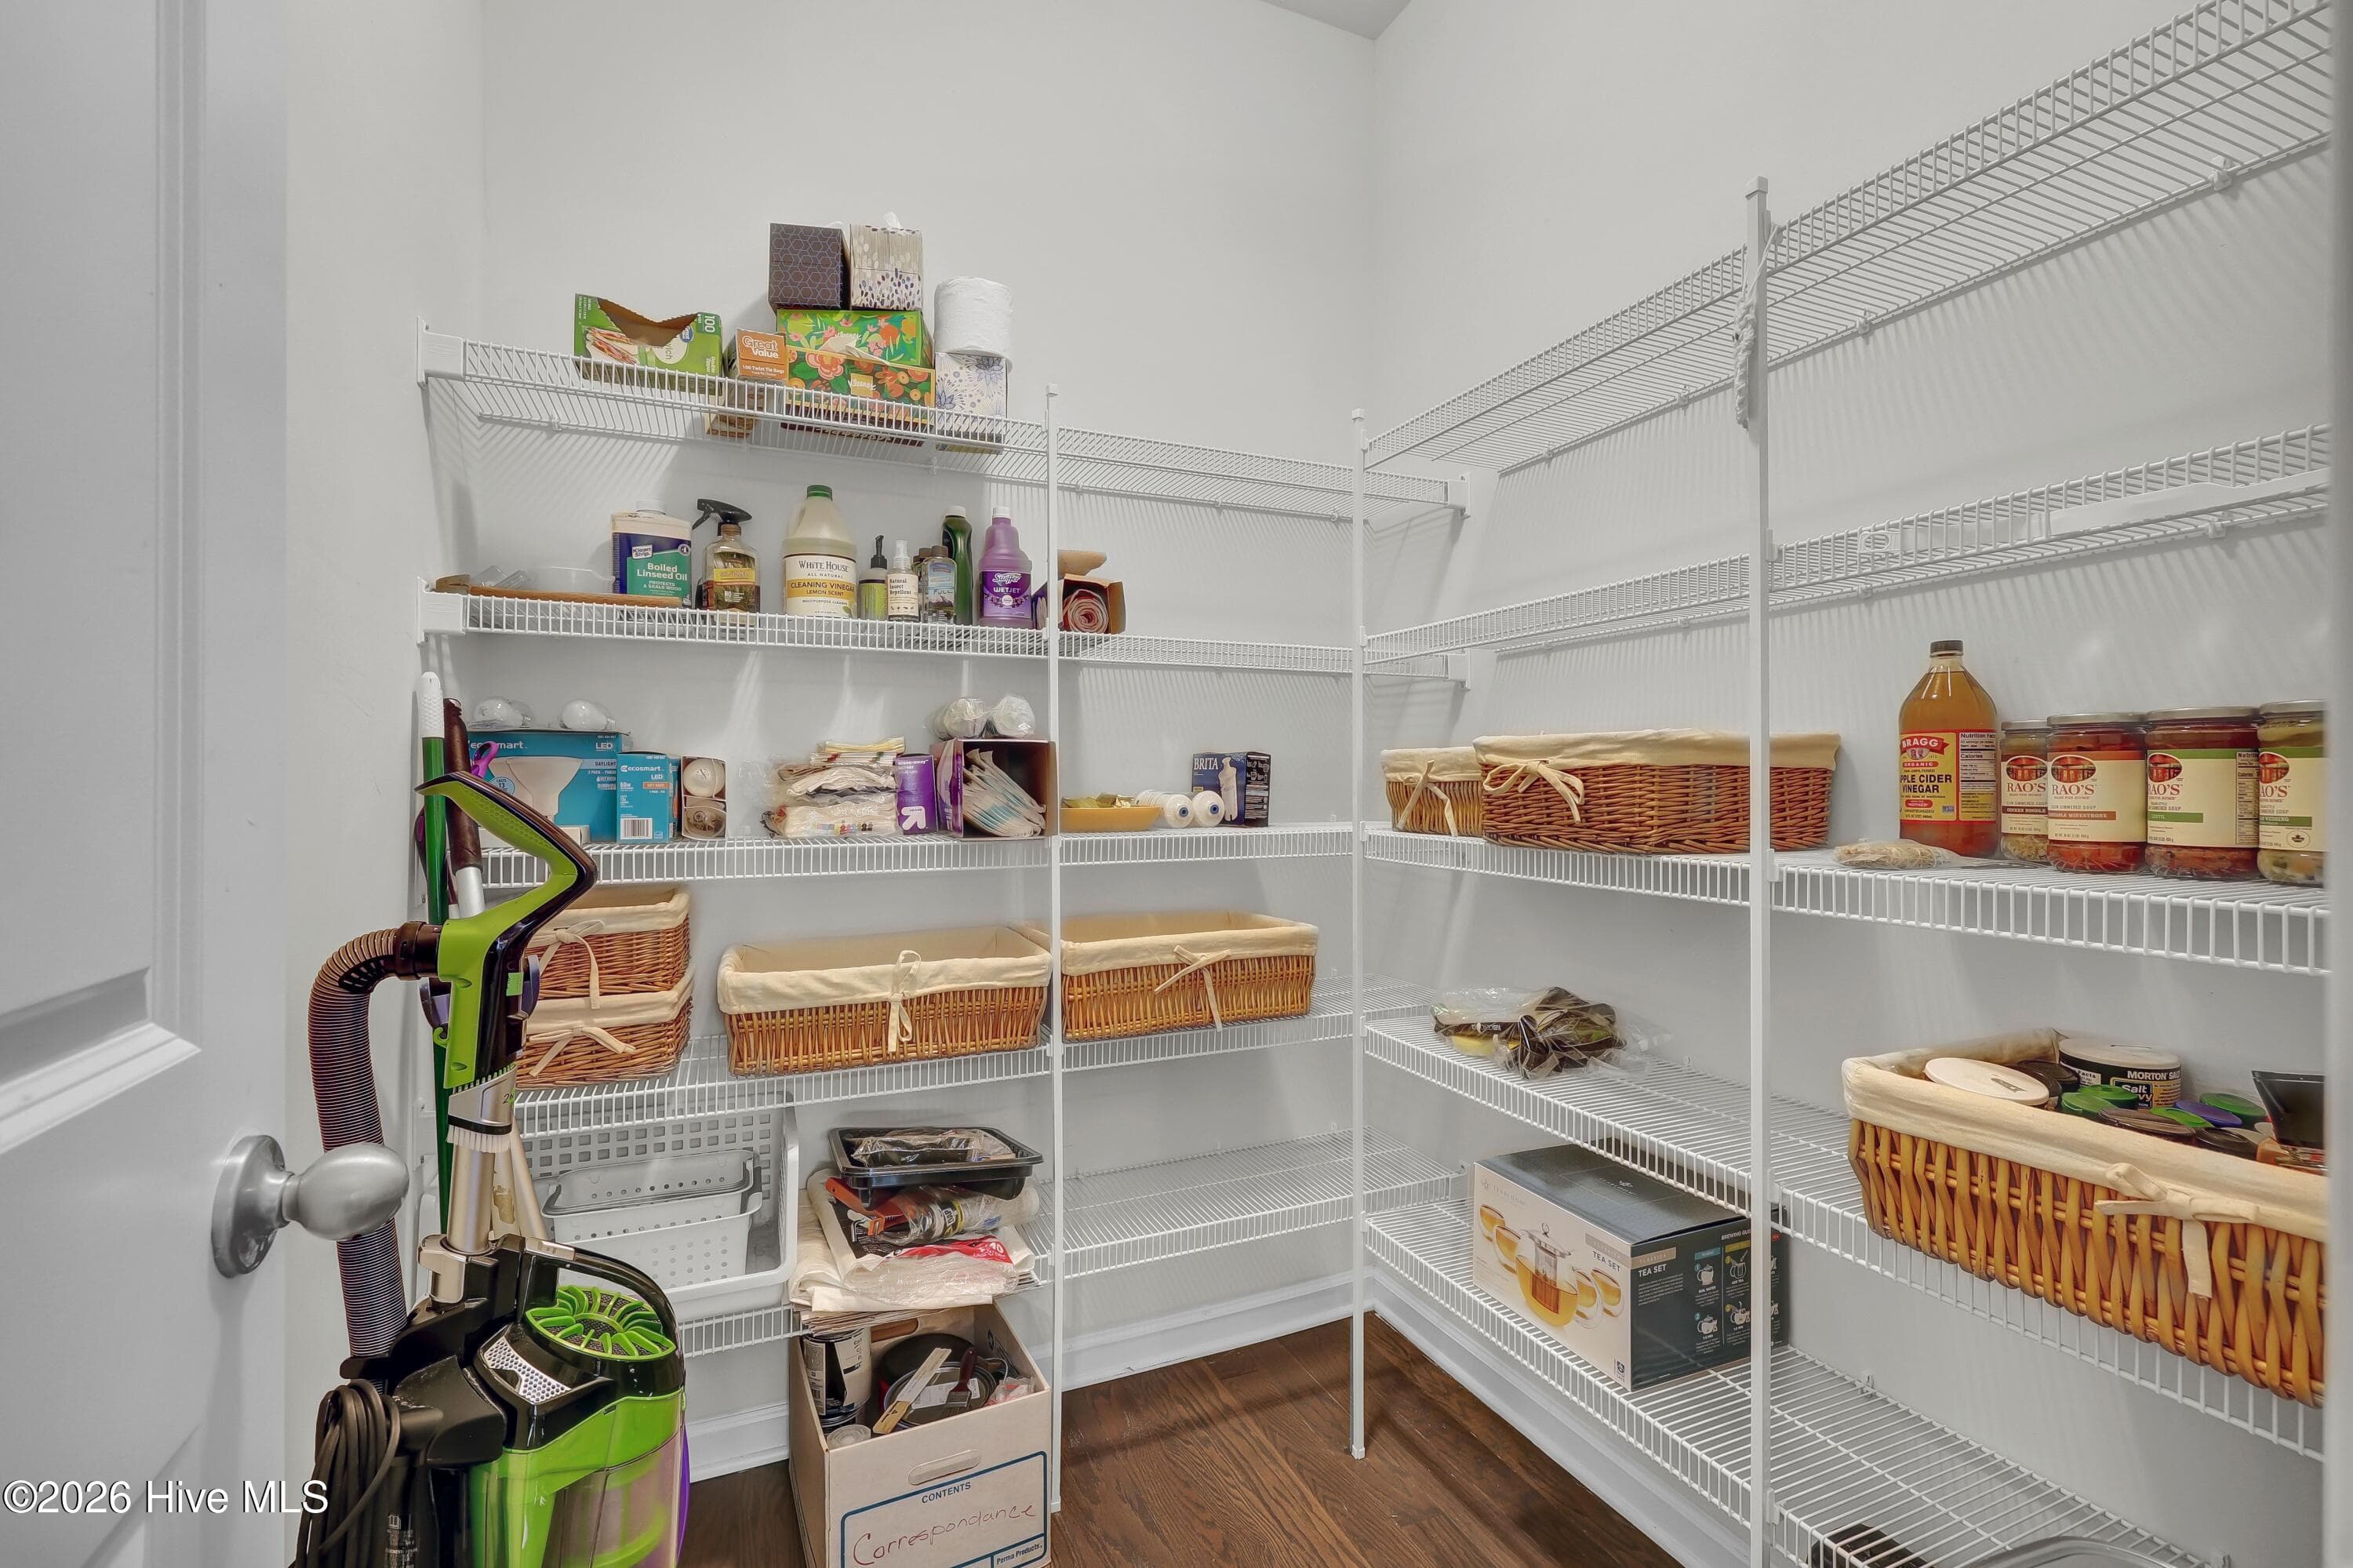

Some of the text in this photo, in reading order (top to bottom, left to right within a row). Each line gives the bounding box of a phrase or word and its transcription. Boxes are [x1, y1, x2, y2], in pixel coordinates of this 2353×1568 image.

[704, 315, 715, 333] 100
[742, 335, 778, 351] Great
[751, 348, 779, 358] Value
[647, 562, 678, 573] Boiled
[826, 561, 849, 573] HOUSE
[637, 569, 687, 581] Linseed Oil
[991, 572, 1022, 585] Swiffer
[829, 583, 855, 591] VINEGA
[471, 740, 525, 749] ecmart
[1902, 737, 1939, 748] BRAGG
[1194, 757, 1219, 770] BRITA
[1918, 774, 1952, 783] CIDER
[1903, 784, 1940, 793] VINEGAR
[2007, 782, 2046, 792] RAO'S
[2052, 784, 2095, 795] RAO'S
[2260, 785, 2289, 798] AO'S
[2078, 1070, 2097, 1079] Facts
[2127, 1070, 2167, 1081] MORTON
[2121, 1084, 2148, 1093] Salt
[944, 1210, 955, 1224] DAP
[1721, 1231, 1741, 1241] BREWING
[1593, 1251, 1621, 1273] TEA SET
[1638, 1264, 1667, 1278] TEA SET
[922, 1482, 972, 1504] CONTENTS
[853, 1504, 1036, 1566] Correspondance
[996, 1554, 1014, 1565] Perma
